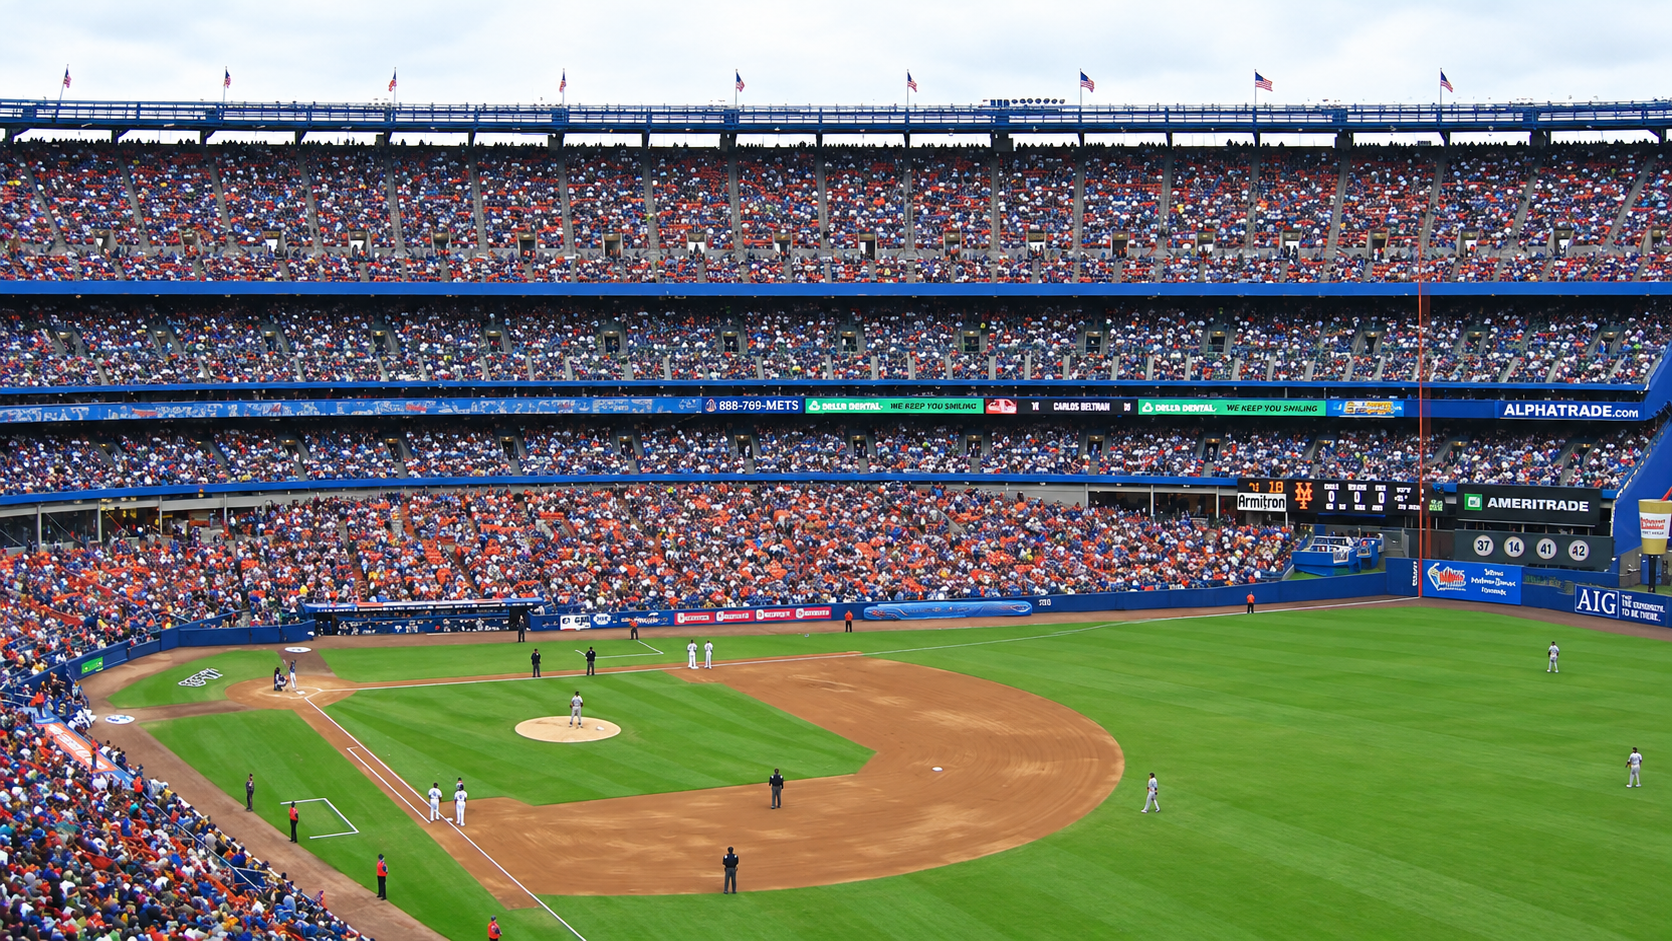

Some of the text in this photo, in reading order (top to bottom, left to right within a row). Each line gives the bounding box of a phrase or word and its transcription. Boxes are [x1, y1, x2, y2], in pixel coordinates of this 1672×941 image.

[926, 402, 943, 410] YOU
[1053, 402, 1110, 411] CARLOS BELTRAN
[1226, 403, 1318, 413] WE KEEP YOU SMILING
[1504, 403, 1639, 418] ALPHATRADE.com
[1238, 494, 1285, 509] Armitron
[1487, 497, 1590, 512] AMERITRADE
[1477, 540, 1490, 551] 37
[1508, 541, 1520, 553] 14
[1540, 543, 1552, 554] 41
[1572, 545, 1585, 557] 42
[1576, 588, 1616, 614] AIG
